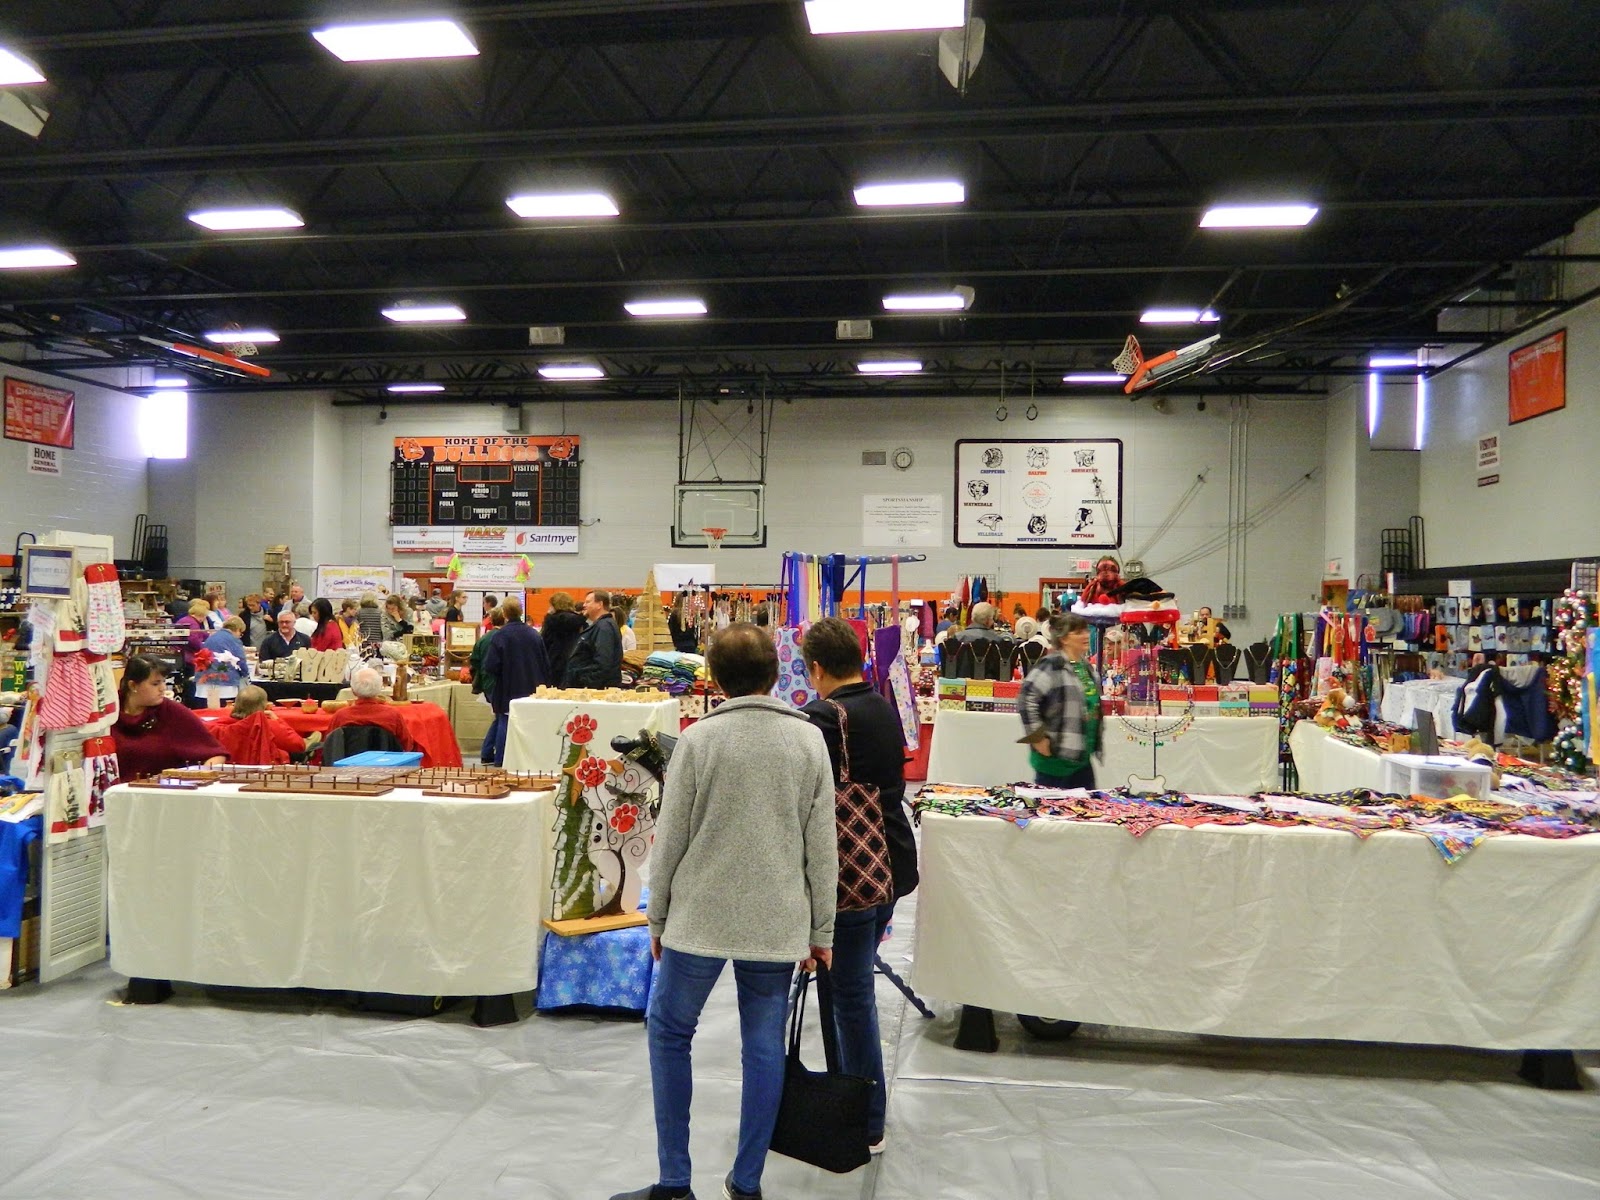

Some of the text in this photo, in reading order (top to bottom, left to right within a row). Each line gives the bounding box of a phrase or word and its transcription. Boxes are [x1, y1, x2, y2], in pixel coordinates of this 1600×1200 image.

[34, 447, 56, 461] HOME
[433, 446, 539, 462] BULLDOGS
[529, 533, 577, 546] Santmyer
